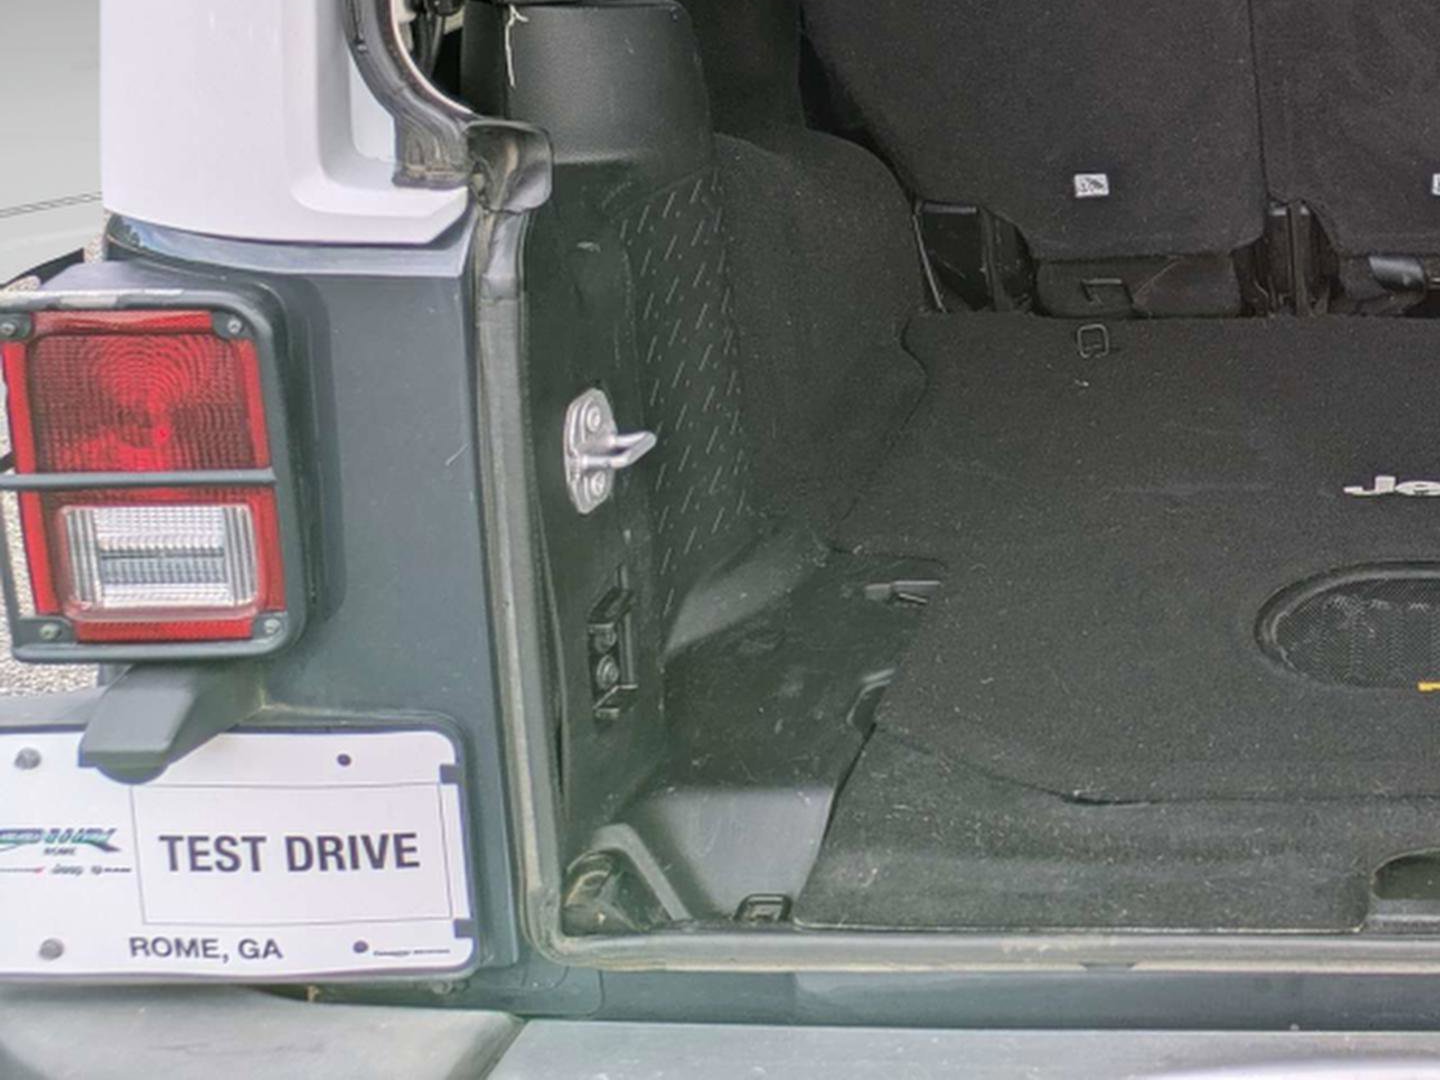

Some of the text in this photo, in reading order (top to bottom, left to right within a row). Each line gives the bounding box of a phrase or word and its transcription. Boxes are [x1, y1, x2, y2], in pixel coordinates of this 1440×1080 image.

[158, 834, 267, 872] TEST
[285, 832, 421, 872] DRIVE
[129, 936, 284, 964] ROME, GA
